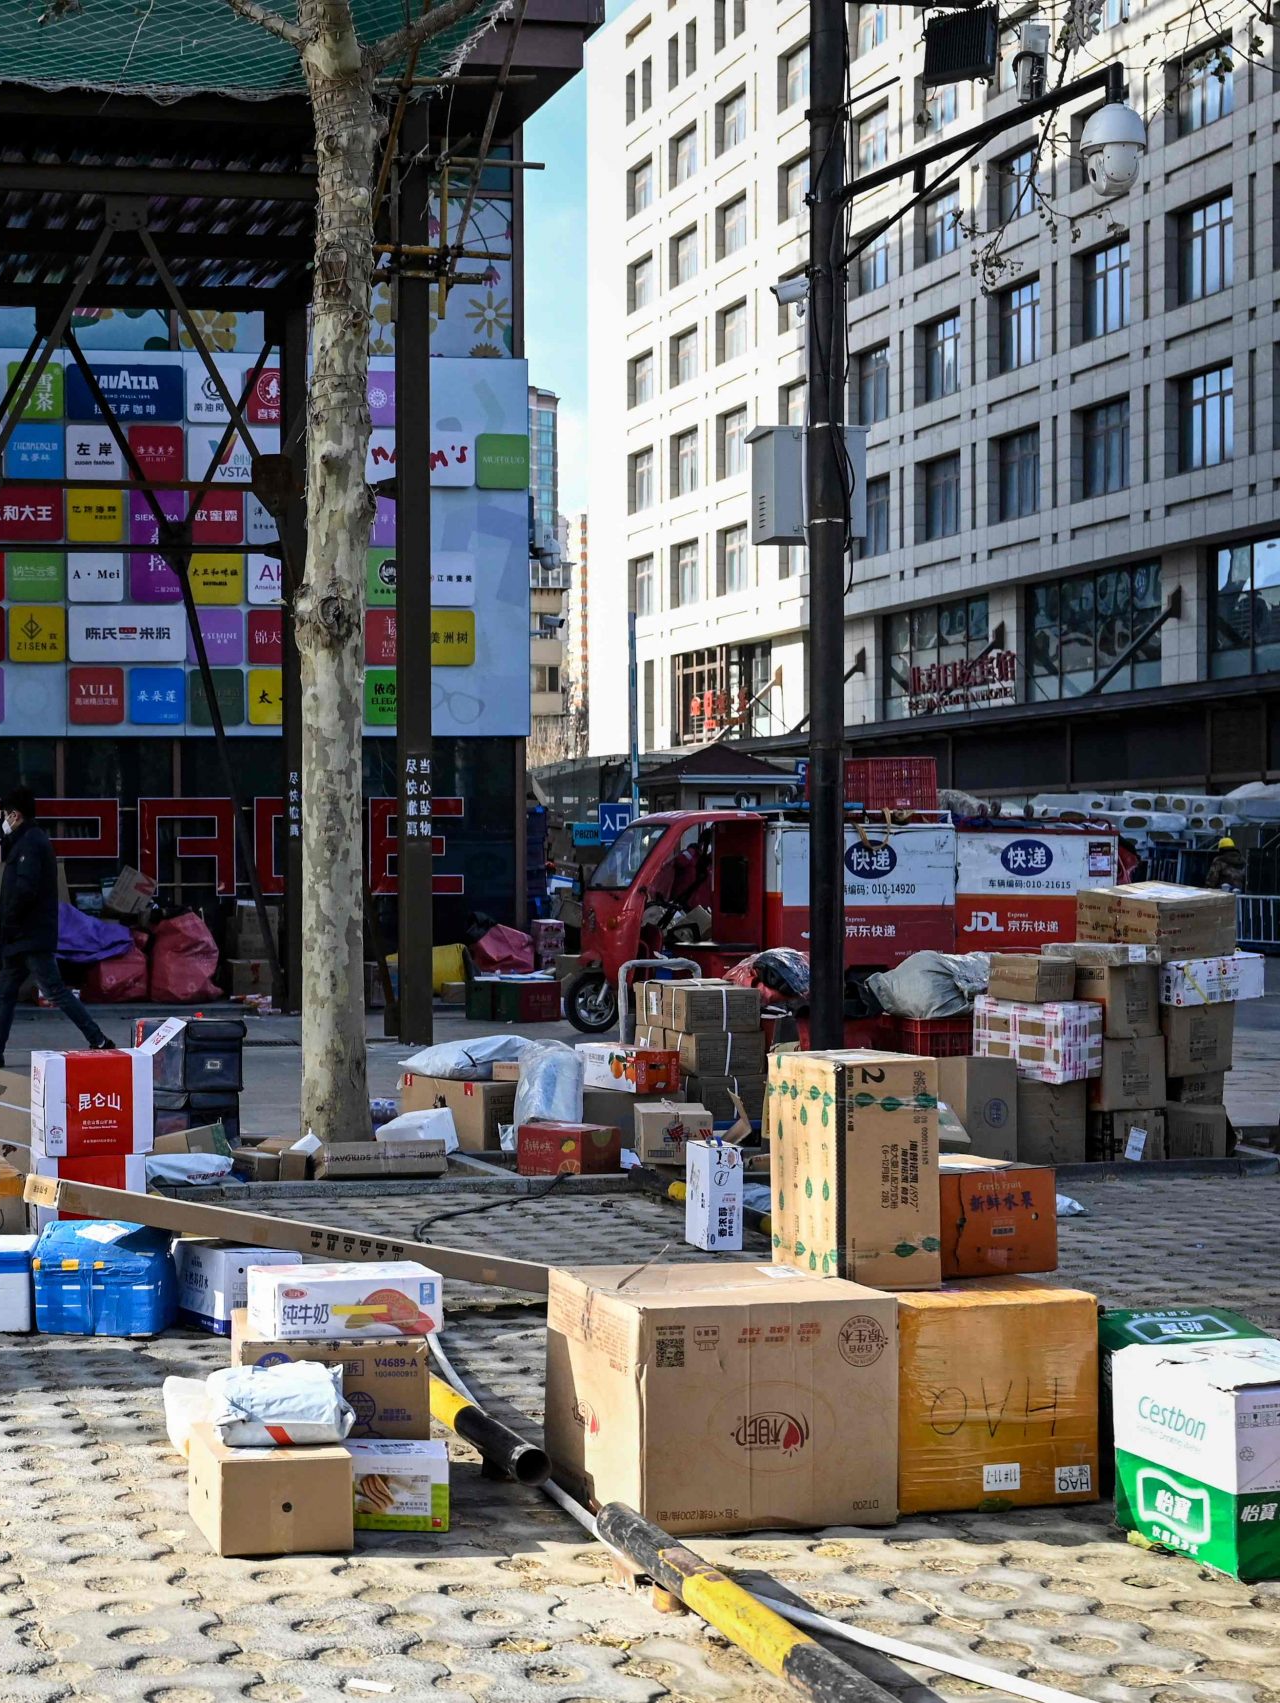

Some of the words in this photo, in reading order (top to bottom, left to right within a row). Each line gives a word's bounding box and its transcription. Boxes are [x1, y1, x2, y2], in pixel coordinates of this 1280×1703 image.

[75, 442, 113, 456] 左岸
[194, 509, 238, 522] 欧蜜露
[85, 626, 118, 641] 陈氏
[139, 626, 172, 641] 米粉
[79, 684, 114, 696] YULI
[404, 757, 419, 838] 尽快撤离
[419, 757, 433, 838] 当心坠物
[602, 813, 630, 832] 入口
[850, 847, 891, 871] 快递
[1007, 846, 1047, 870] 快递
[962, 910, 1005, 933] JDL
[1007, 919, 1059, 934] 京东快递
[845, 925, 896, 938] 京东快递
[861, 1067, 886, 1085] 2
[78, 1092, 122, 1112] 昆仑山
[976, 1179, 999, 1191] Fresh
[1001, 1179, 1023, 1190] Fruit
[968, 1190, 1035, 1214] 新鲜水果
[281, 1303, 330, 1326] 纯牛奶
[374, 1357, 418, 1368] V4689-A
[1137, 1394, 1207, 1442] C'estbon
[851, 1499, 880, 1511] DT200
